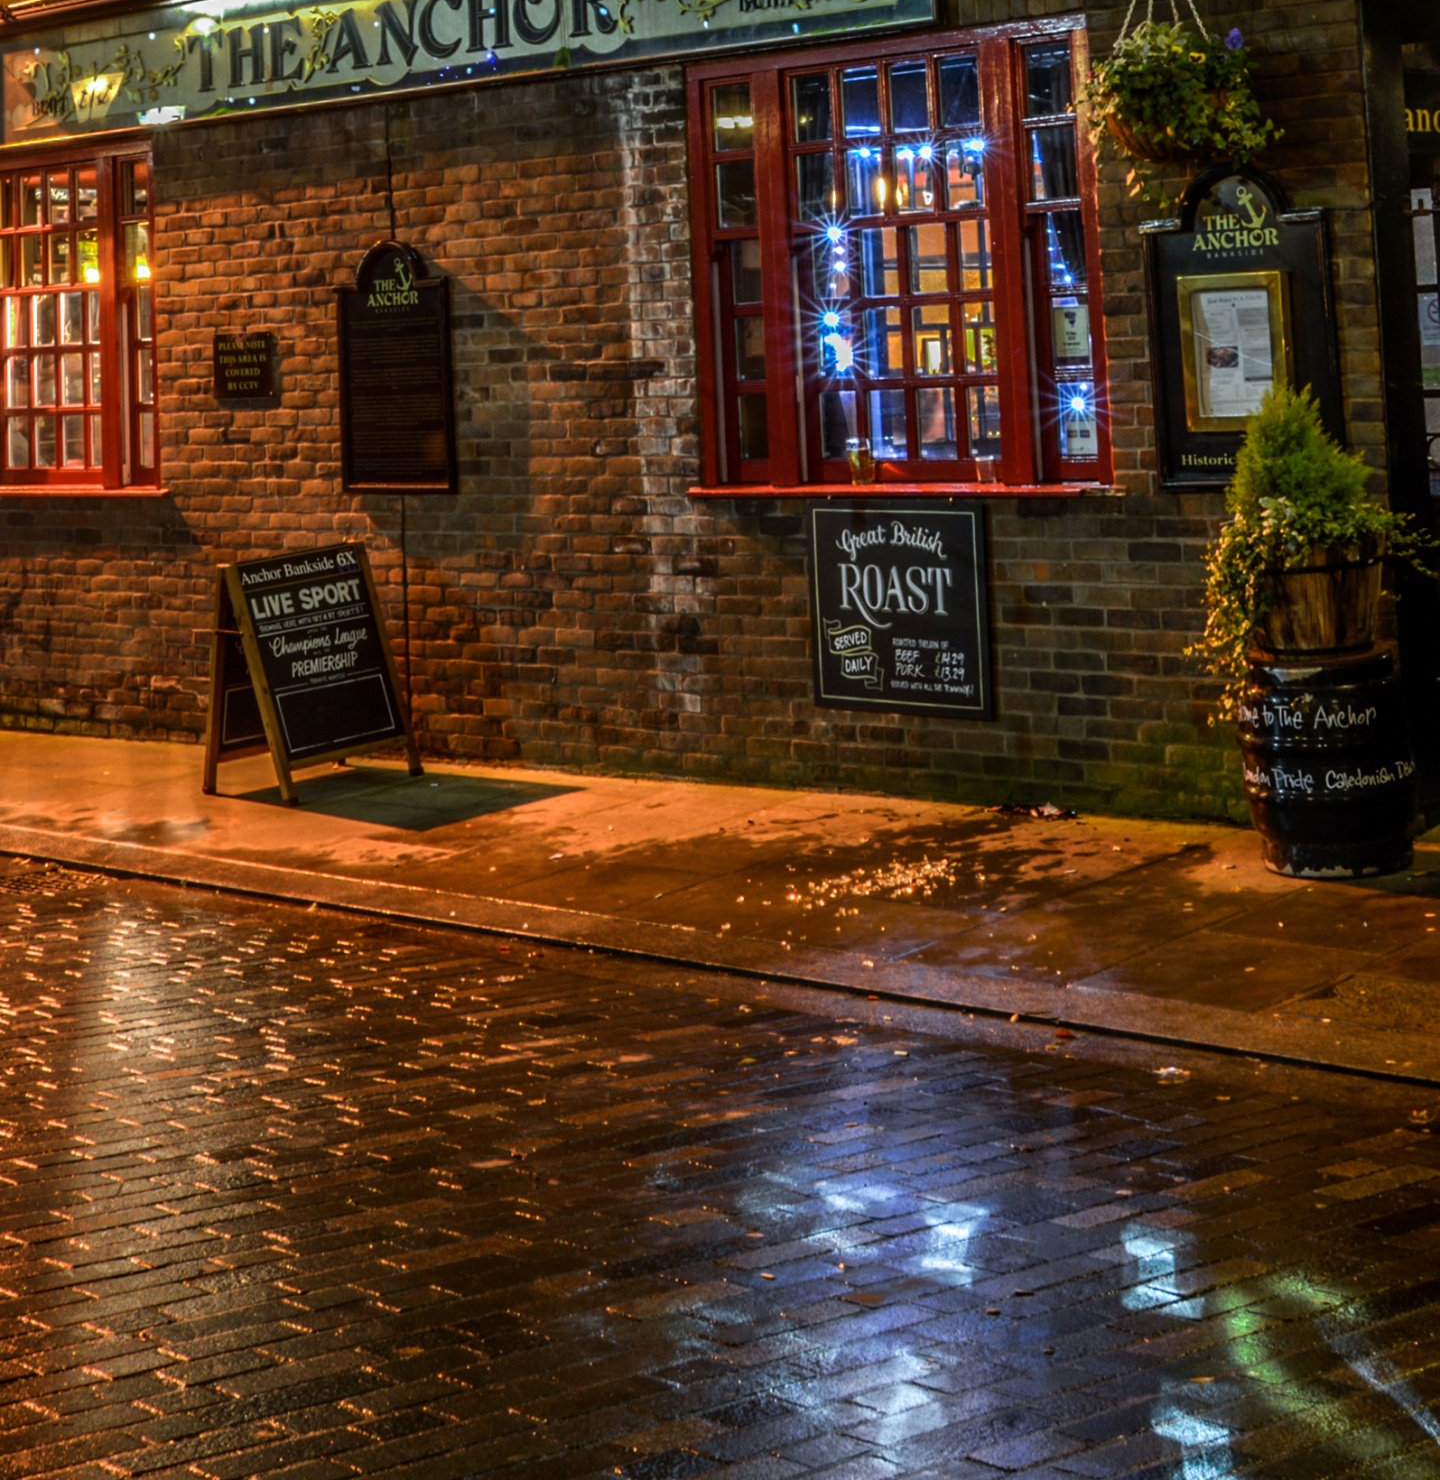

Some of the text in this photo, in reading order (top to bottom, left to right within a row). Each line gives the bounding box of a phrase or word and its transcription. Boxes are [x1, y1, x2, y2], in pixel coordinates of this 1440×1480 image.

[188, 16, 303, 93] THE
[1203, 213, 1241, 231] THE
[1192, 227, 1279, 251] ANCHOR
[1206, 248, 1264, 259] BANKSIDE
[373, 278, 396, 292] THE
[367, 290, 419, 307] ANCHOR
[218, 340, 266, 351] PLEASE NOTE
[219, 353, 267, 364] THIS AREA IS
[225, 368, 261, 377] COVERED
[228, 381, 259, 391] BY CCTV
[1181, 452, 1236, 467] Historic
[836, 520, 948, 562] Great British
[241, 551, 357, 586] Anchor Bankside 6X
[251, 579, 361, 620] LIVE SPORT
[837, 563, 953, 629] ROAST
[268, 635, 332, 658] Champions
[334, 627, 368, 650] League
[834, 631, 868, 650] SERVED
[291, 651, 359, 678] PREMIERSHIP
[845, 656, 873, 673] DAILY
[895, 648, 920, 663] BEEF
[895, 662, 926, 678] PORK
[1262, 704, 1275, 727] to
[1274, 705, 1304, 730] The
[1313, 705, 1377, 730] Anchor
[1271, 767, 1315, 790] Pride
